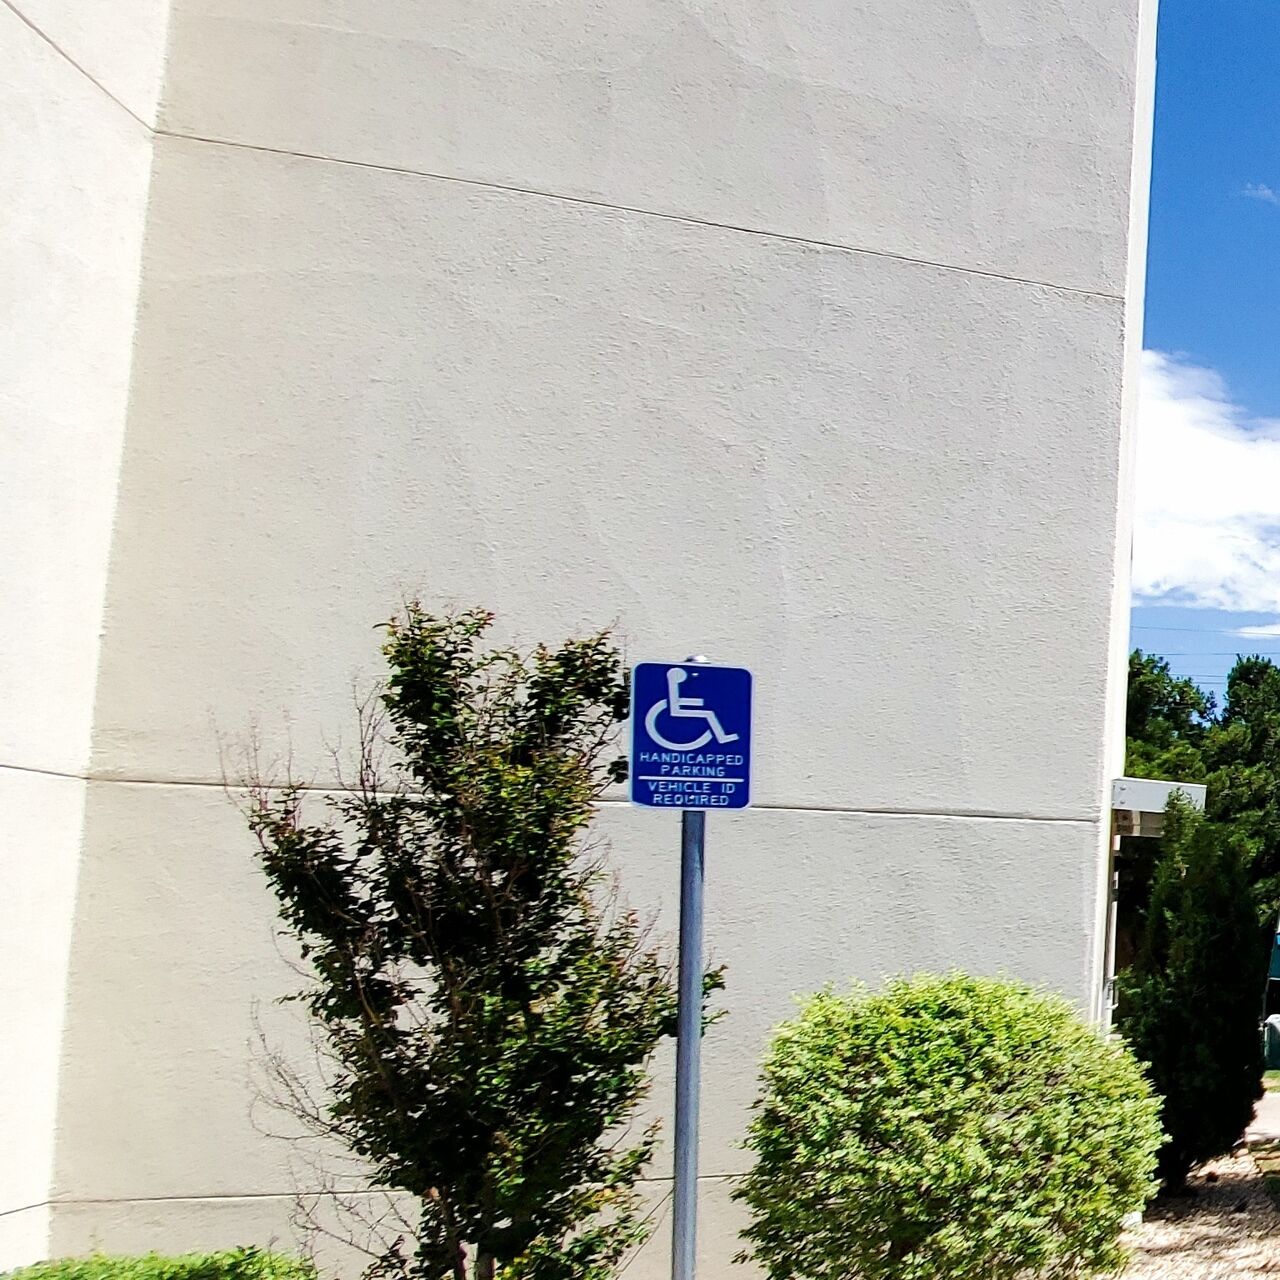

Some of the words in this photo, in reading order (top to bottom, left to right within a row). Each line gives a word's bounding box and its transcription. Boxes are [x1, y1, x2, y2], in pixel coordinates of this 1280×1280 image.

[640, 752, 743, 765] HANDICAPPED
[661, 765, 725, 776] PARKING
[648, 782, 711, 793] VEHICLE
[722, 783, 735, 793] ID
[653, 794, 729, 805] REQUIRED
